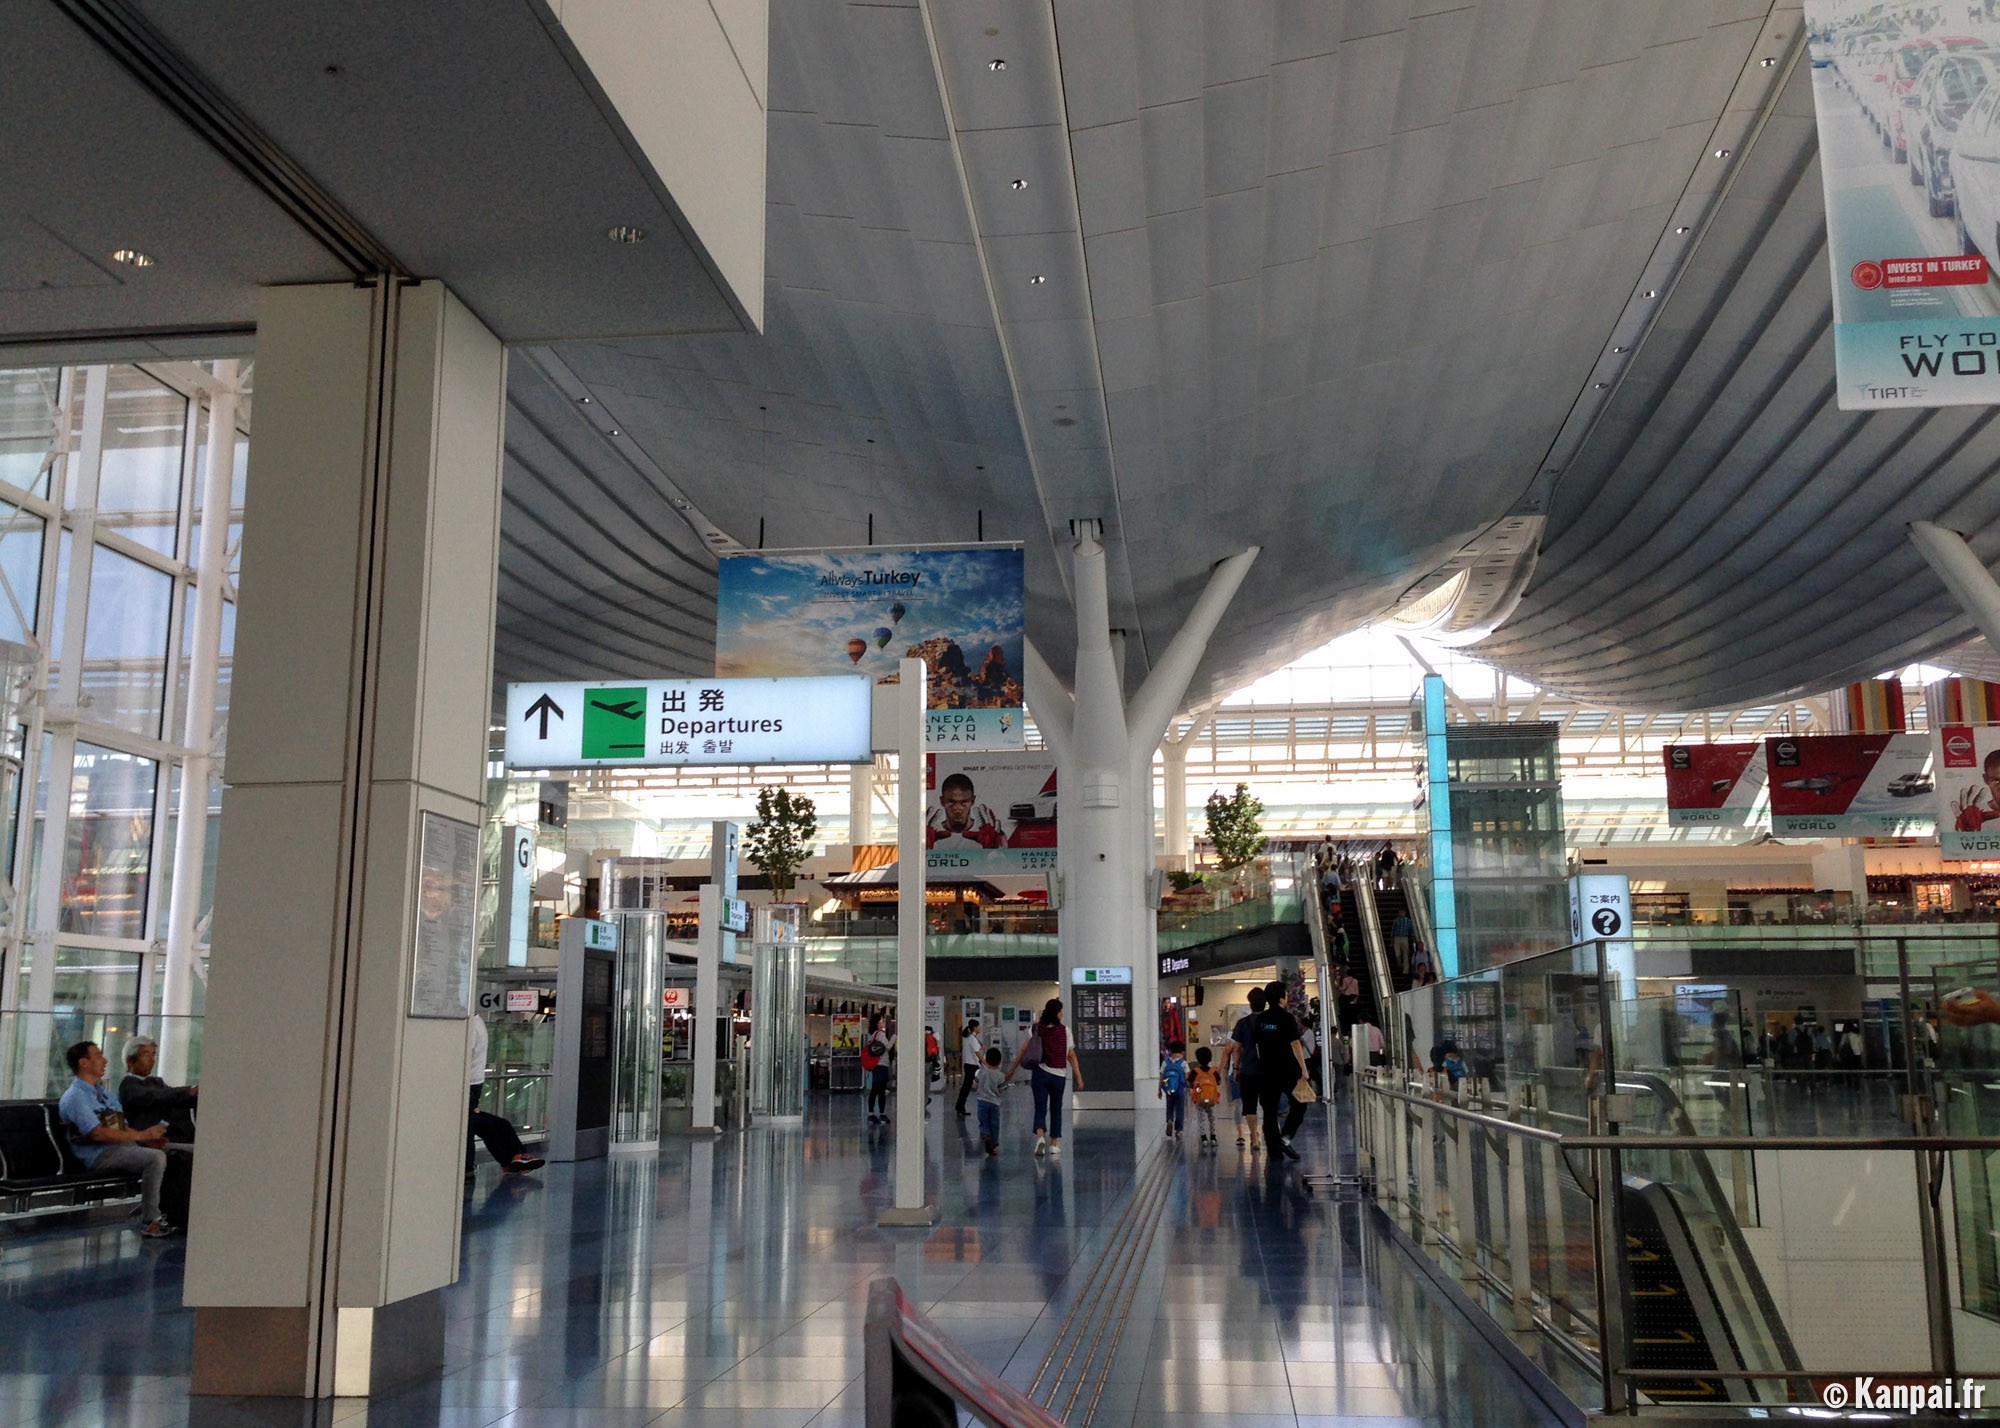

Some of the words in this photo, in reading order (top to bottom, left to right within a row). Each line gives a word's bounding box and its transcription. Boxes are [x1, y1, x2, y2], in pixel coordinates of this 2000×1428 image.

[1887, 262, 1923, 273] INVEST
[1926, 262, 1938, 272] IN
[1941, 260, 1981, 271] TURKEY
[1900, 335, 1949, 349] FLY
[1960, 332, 1997, 346] TO
[1901, 350, 2000, 377] WO
[1868, 387, 1909, 399] TIAT
[661, 689, 724, 713] 出発
[927, 715, 975, 723] NEDA
[661, 716, 783, 738] Departures
[660, 741, 690, 755] 出发
[702, 739, 734, 754] 출발
[518, 838, 529, 868] G
[1961, 841, 2000, 851] WOR
[928, 859, 969, 867] ORLD
[1590, 894, 1620, 904] ご案内
[480, 993, 491, 1008] G
